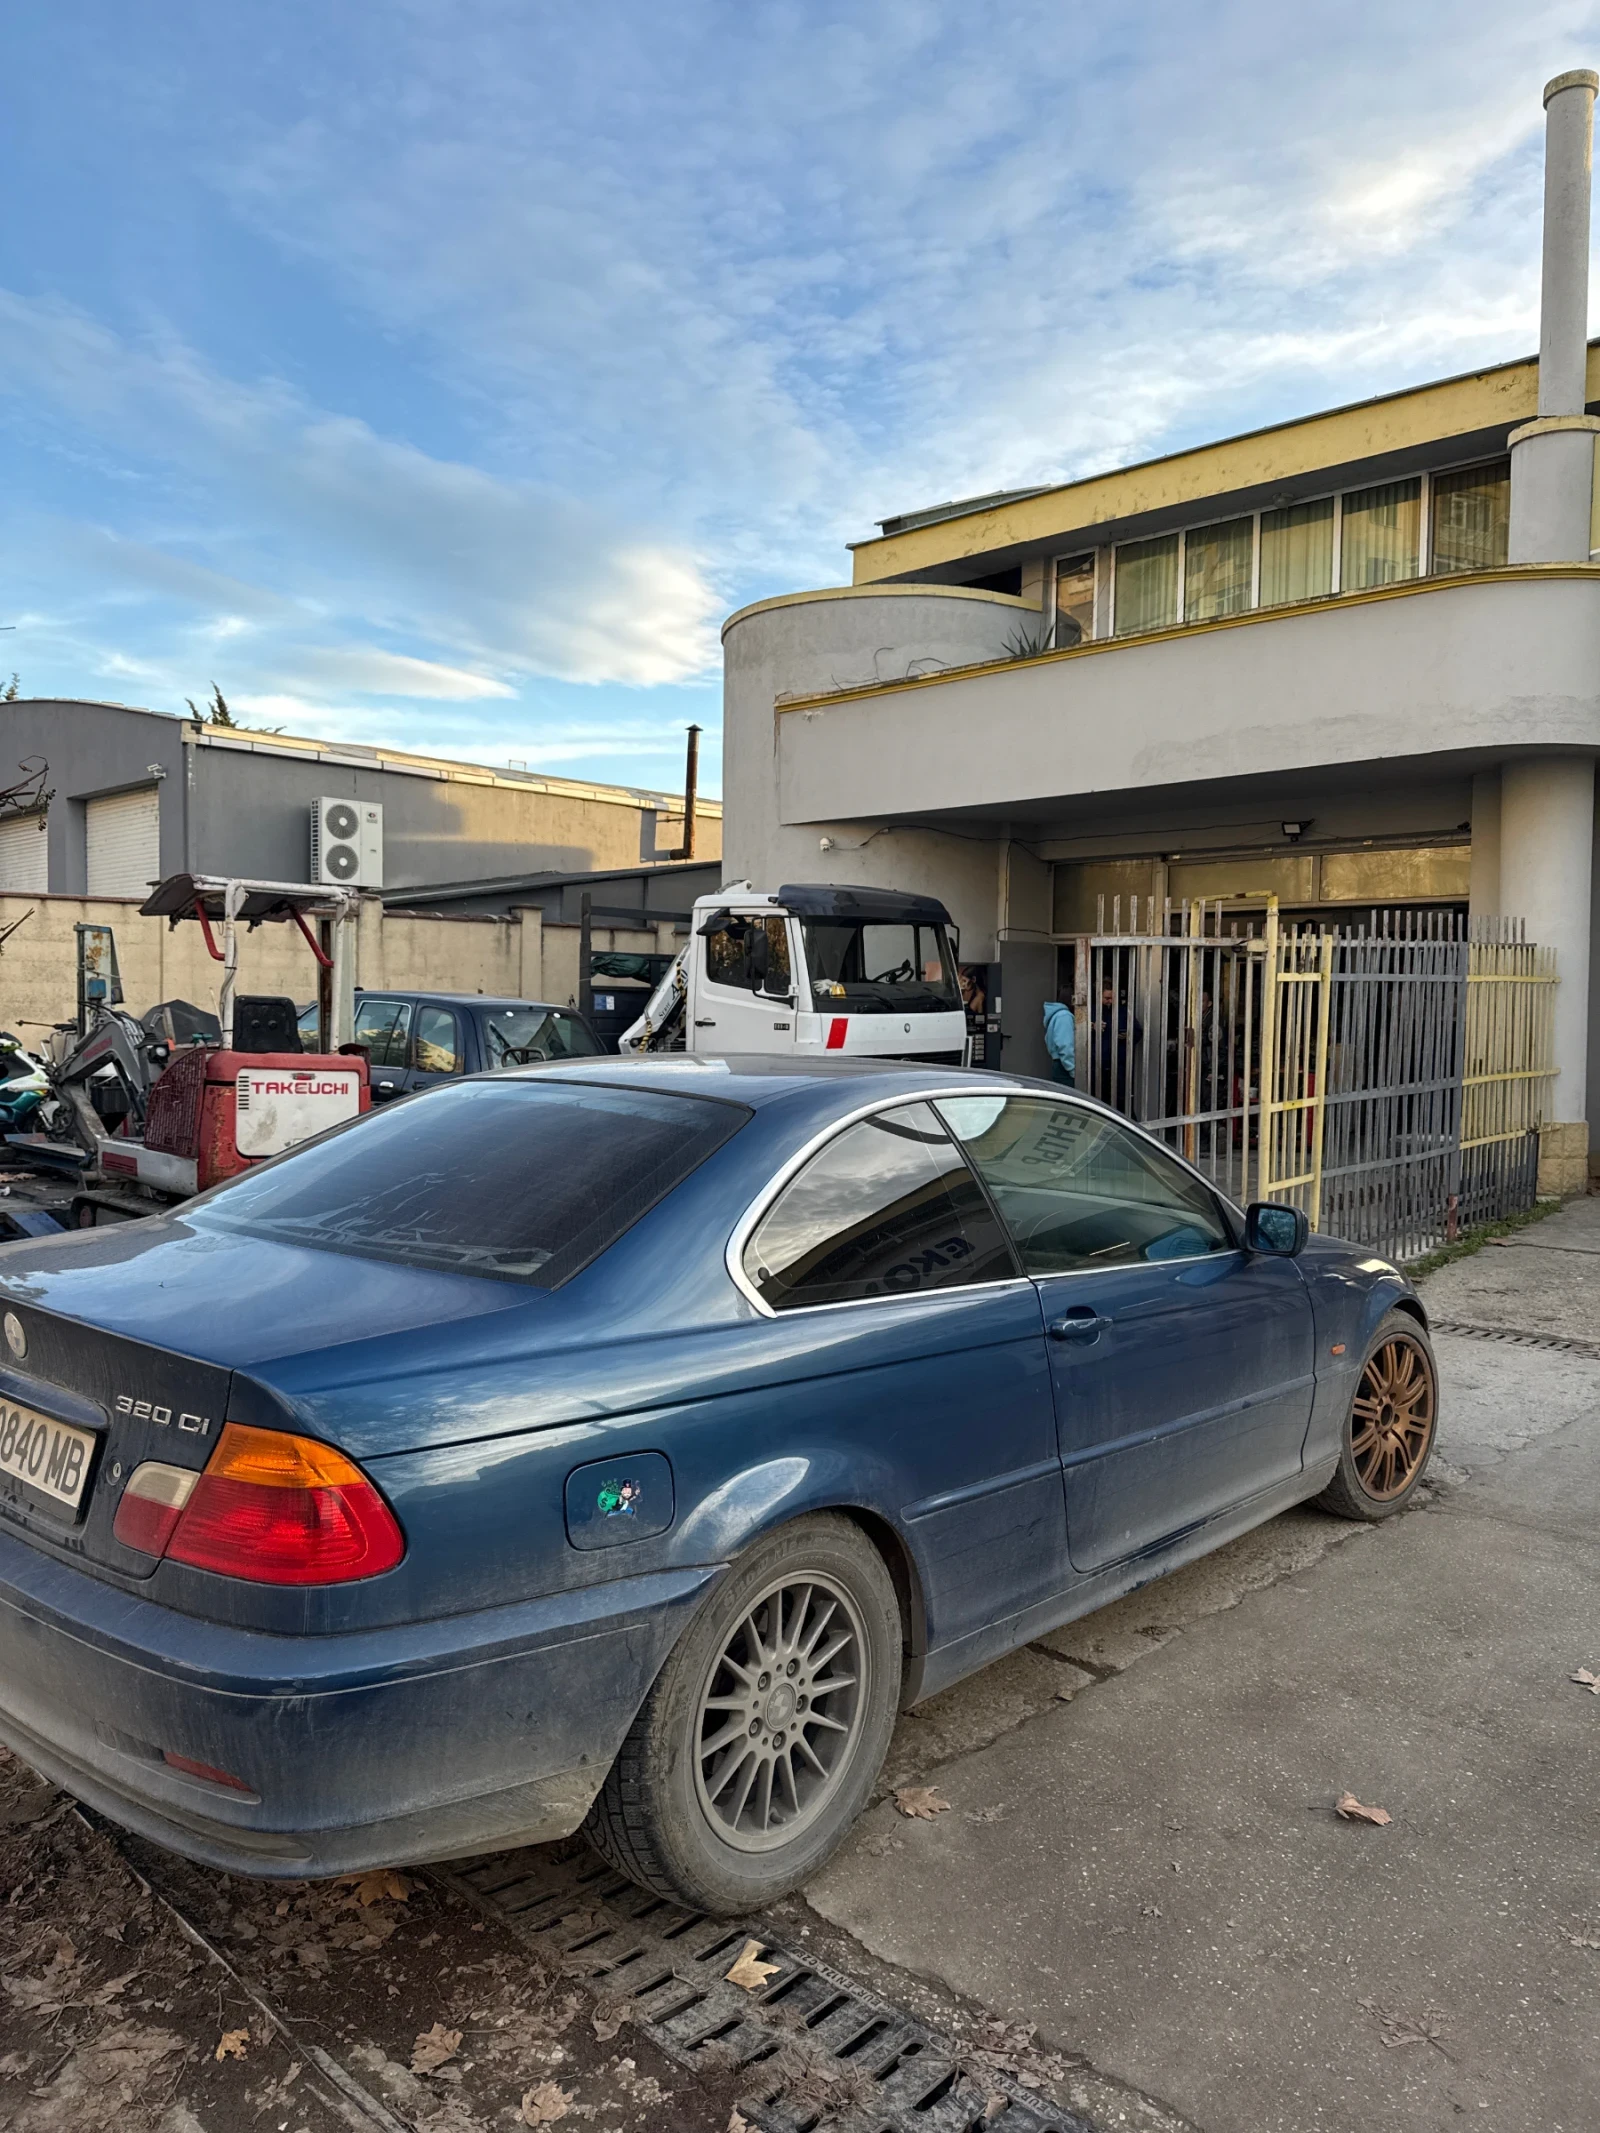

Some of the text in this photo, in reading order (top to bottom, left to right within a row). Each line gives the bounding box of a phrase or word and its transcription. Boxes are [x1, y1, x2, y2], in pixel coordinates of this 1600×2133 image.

[251, 1082, 349, 1095] TAKEUCHI
[115, 1395, 172, 1426] 320
[43, 1430, 86, 1496] MB
